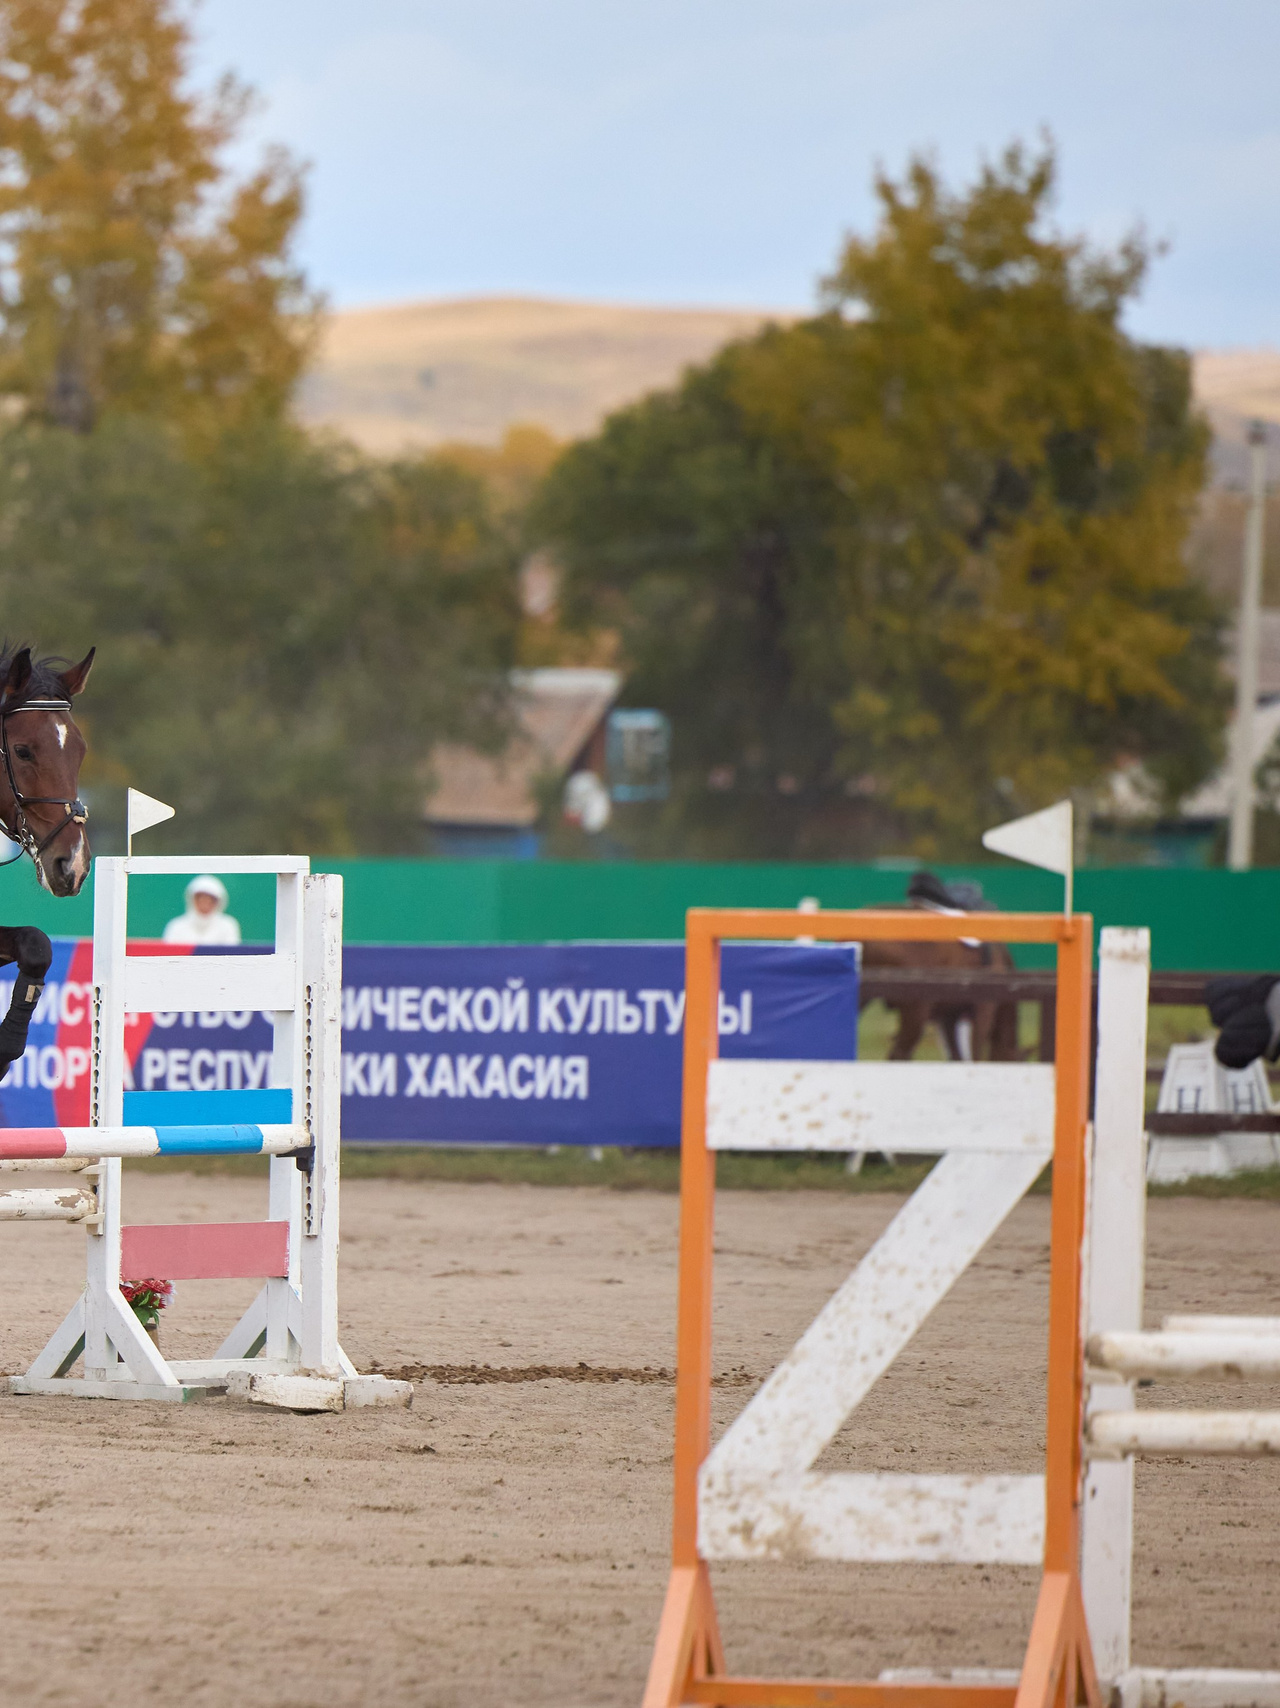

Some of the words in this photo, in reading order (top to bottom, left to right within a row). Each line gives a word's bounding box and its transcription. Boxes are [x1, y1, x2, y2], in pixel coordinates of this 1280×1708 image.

[261, 976, 529, 1033] ИЧЕСКОЙ
[537, 987, 753, 1035] КУЛЬТУЫ
[142, 1048, 397, 1097] РЕСПУКИ
[404, 1053, 589, 1100] ХАКАСИЯ
